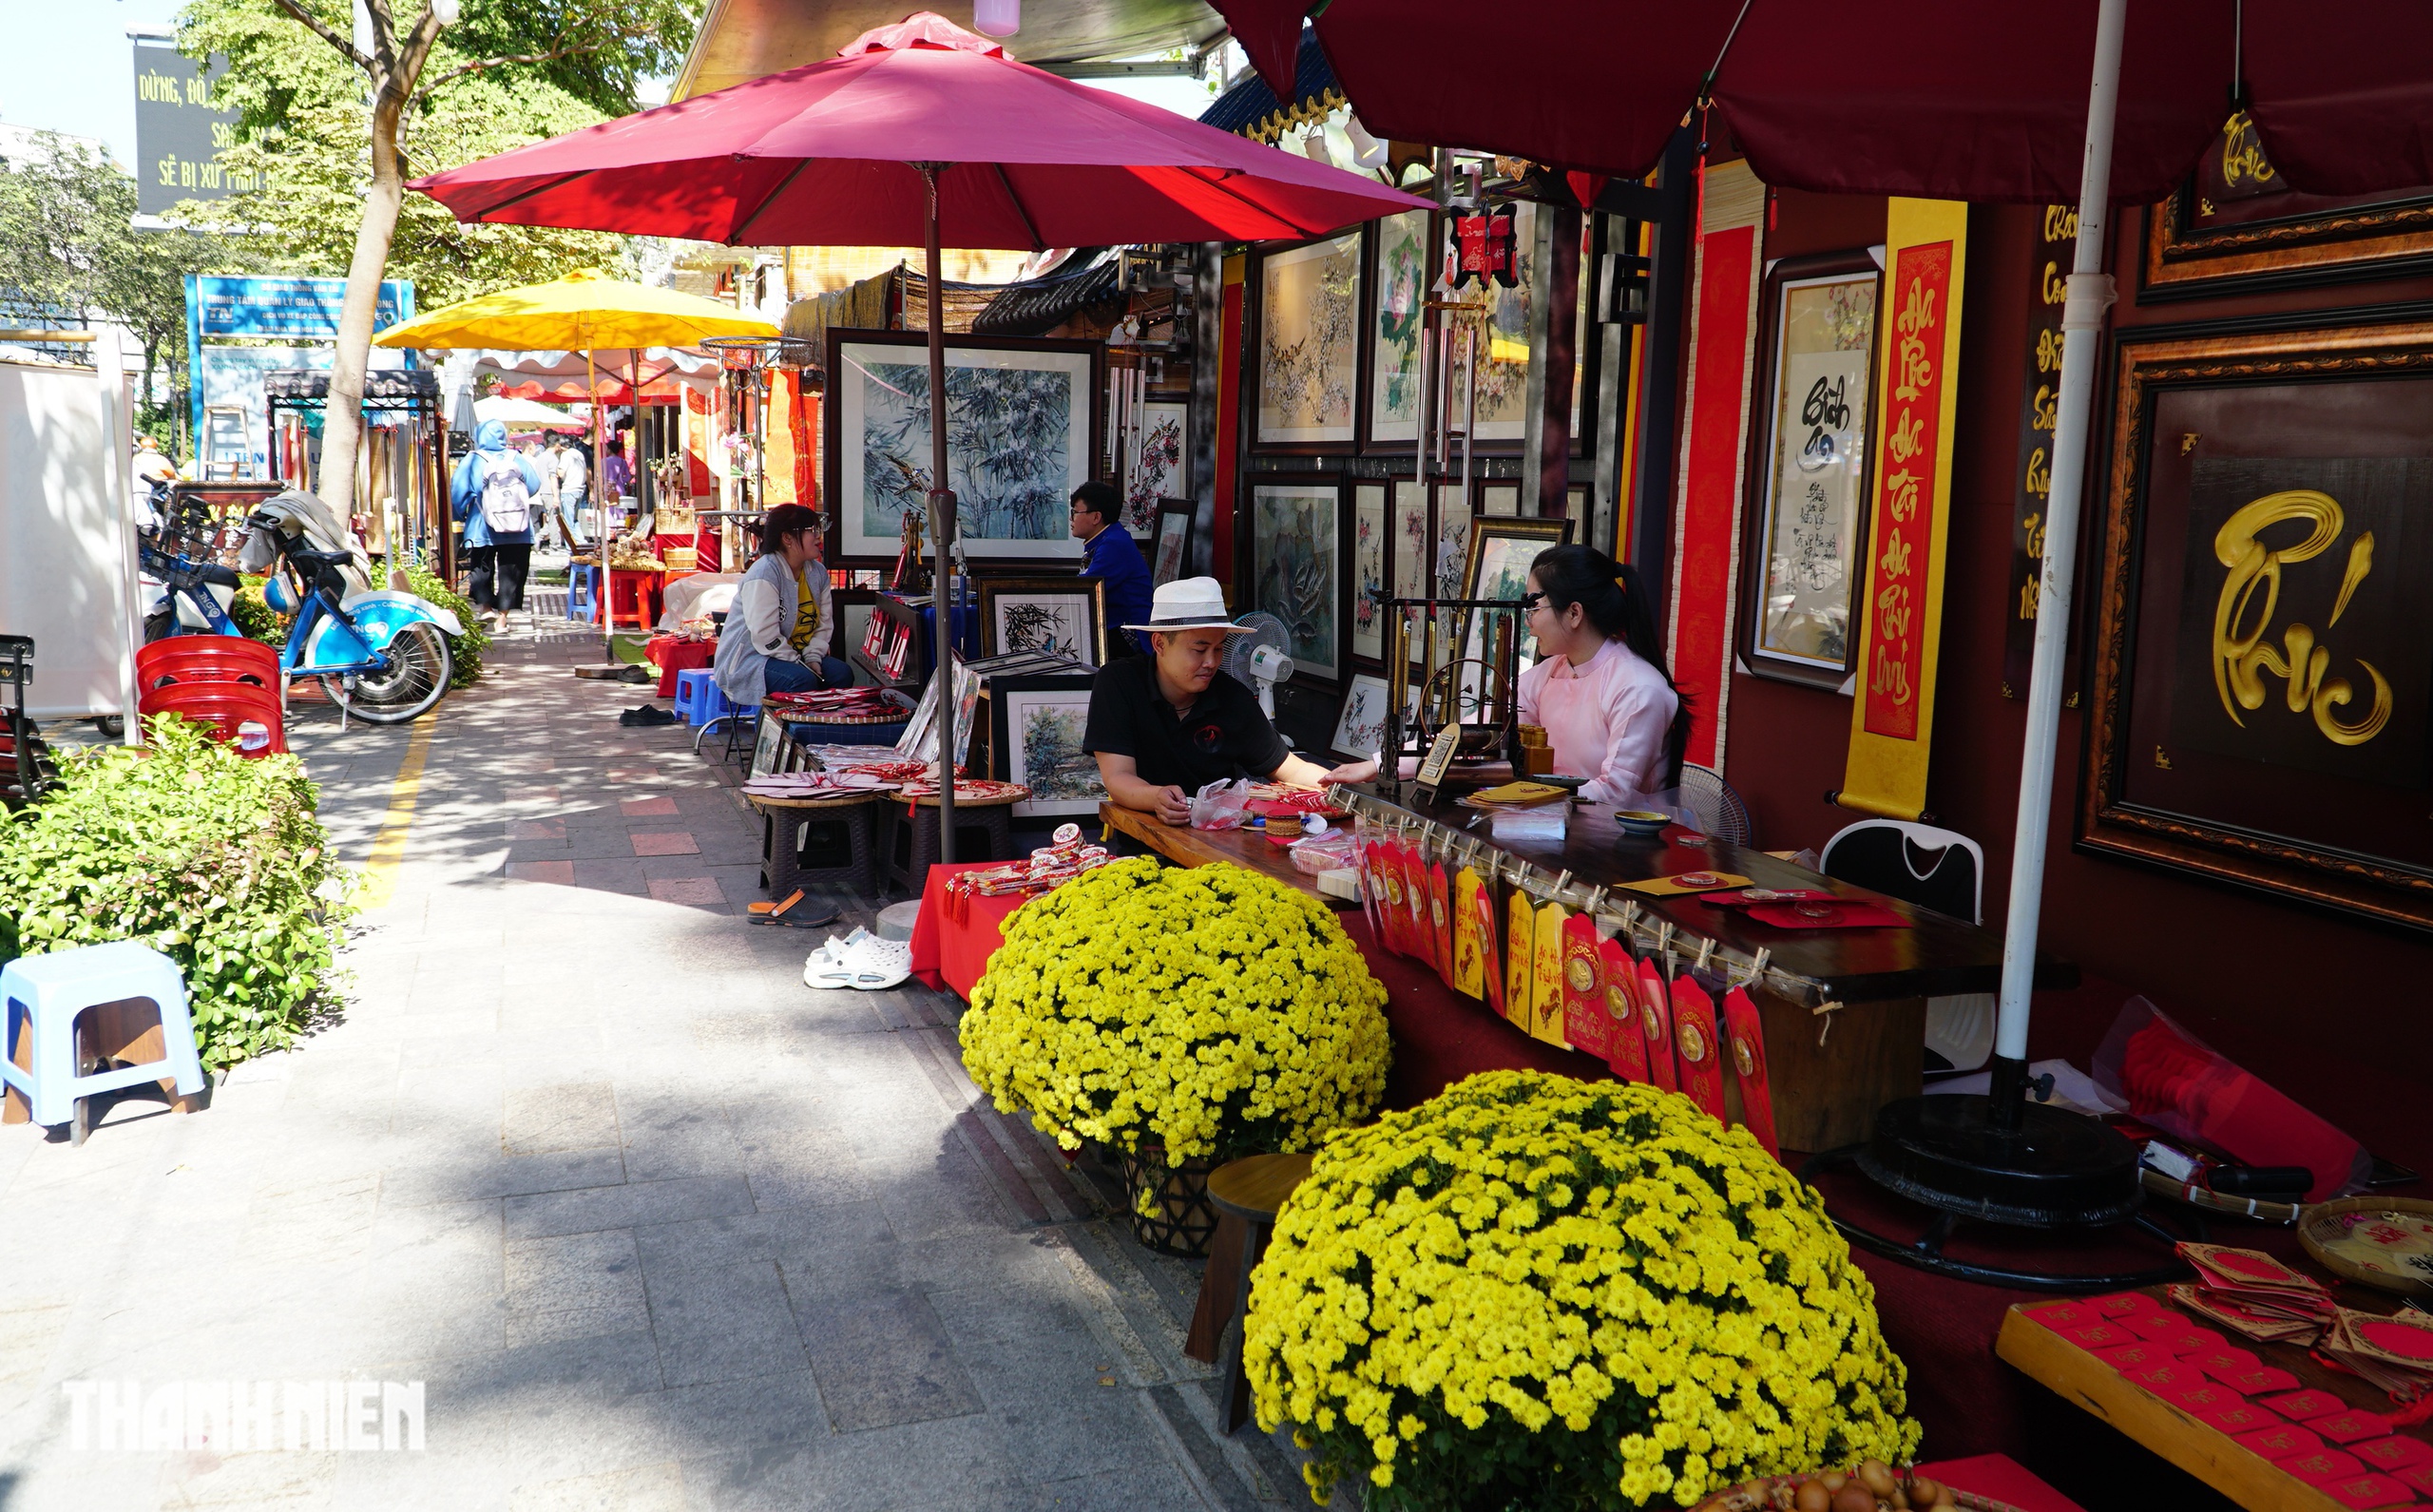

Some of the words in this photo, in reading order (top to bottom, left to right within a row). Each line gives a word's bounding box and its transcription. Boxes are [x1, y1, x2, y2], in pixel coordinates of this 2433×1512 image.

[181, 161, 197, 192] BỊ
[206, 296, 236, 305] TRUNG
[238, 295, 256, 306] TÂM
[295, 297, 316, 307] GIAO
[375, 297, 394, 311] ỘNG
[207, 307, 234, 319] TN
